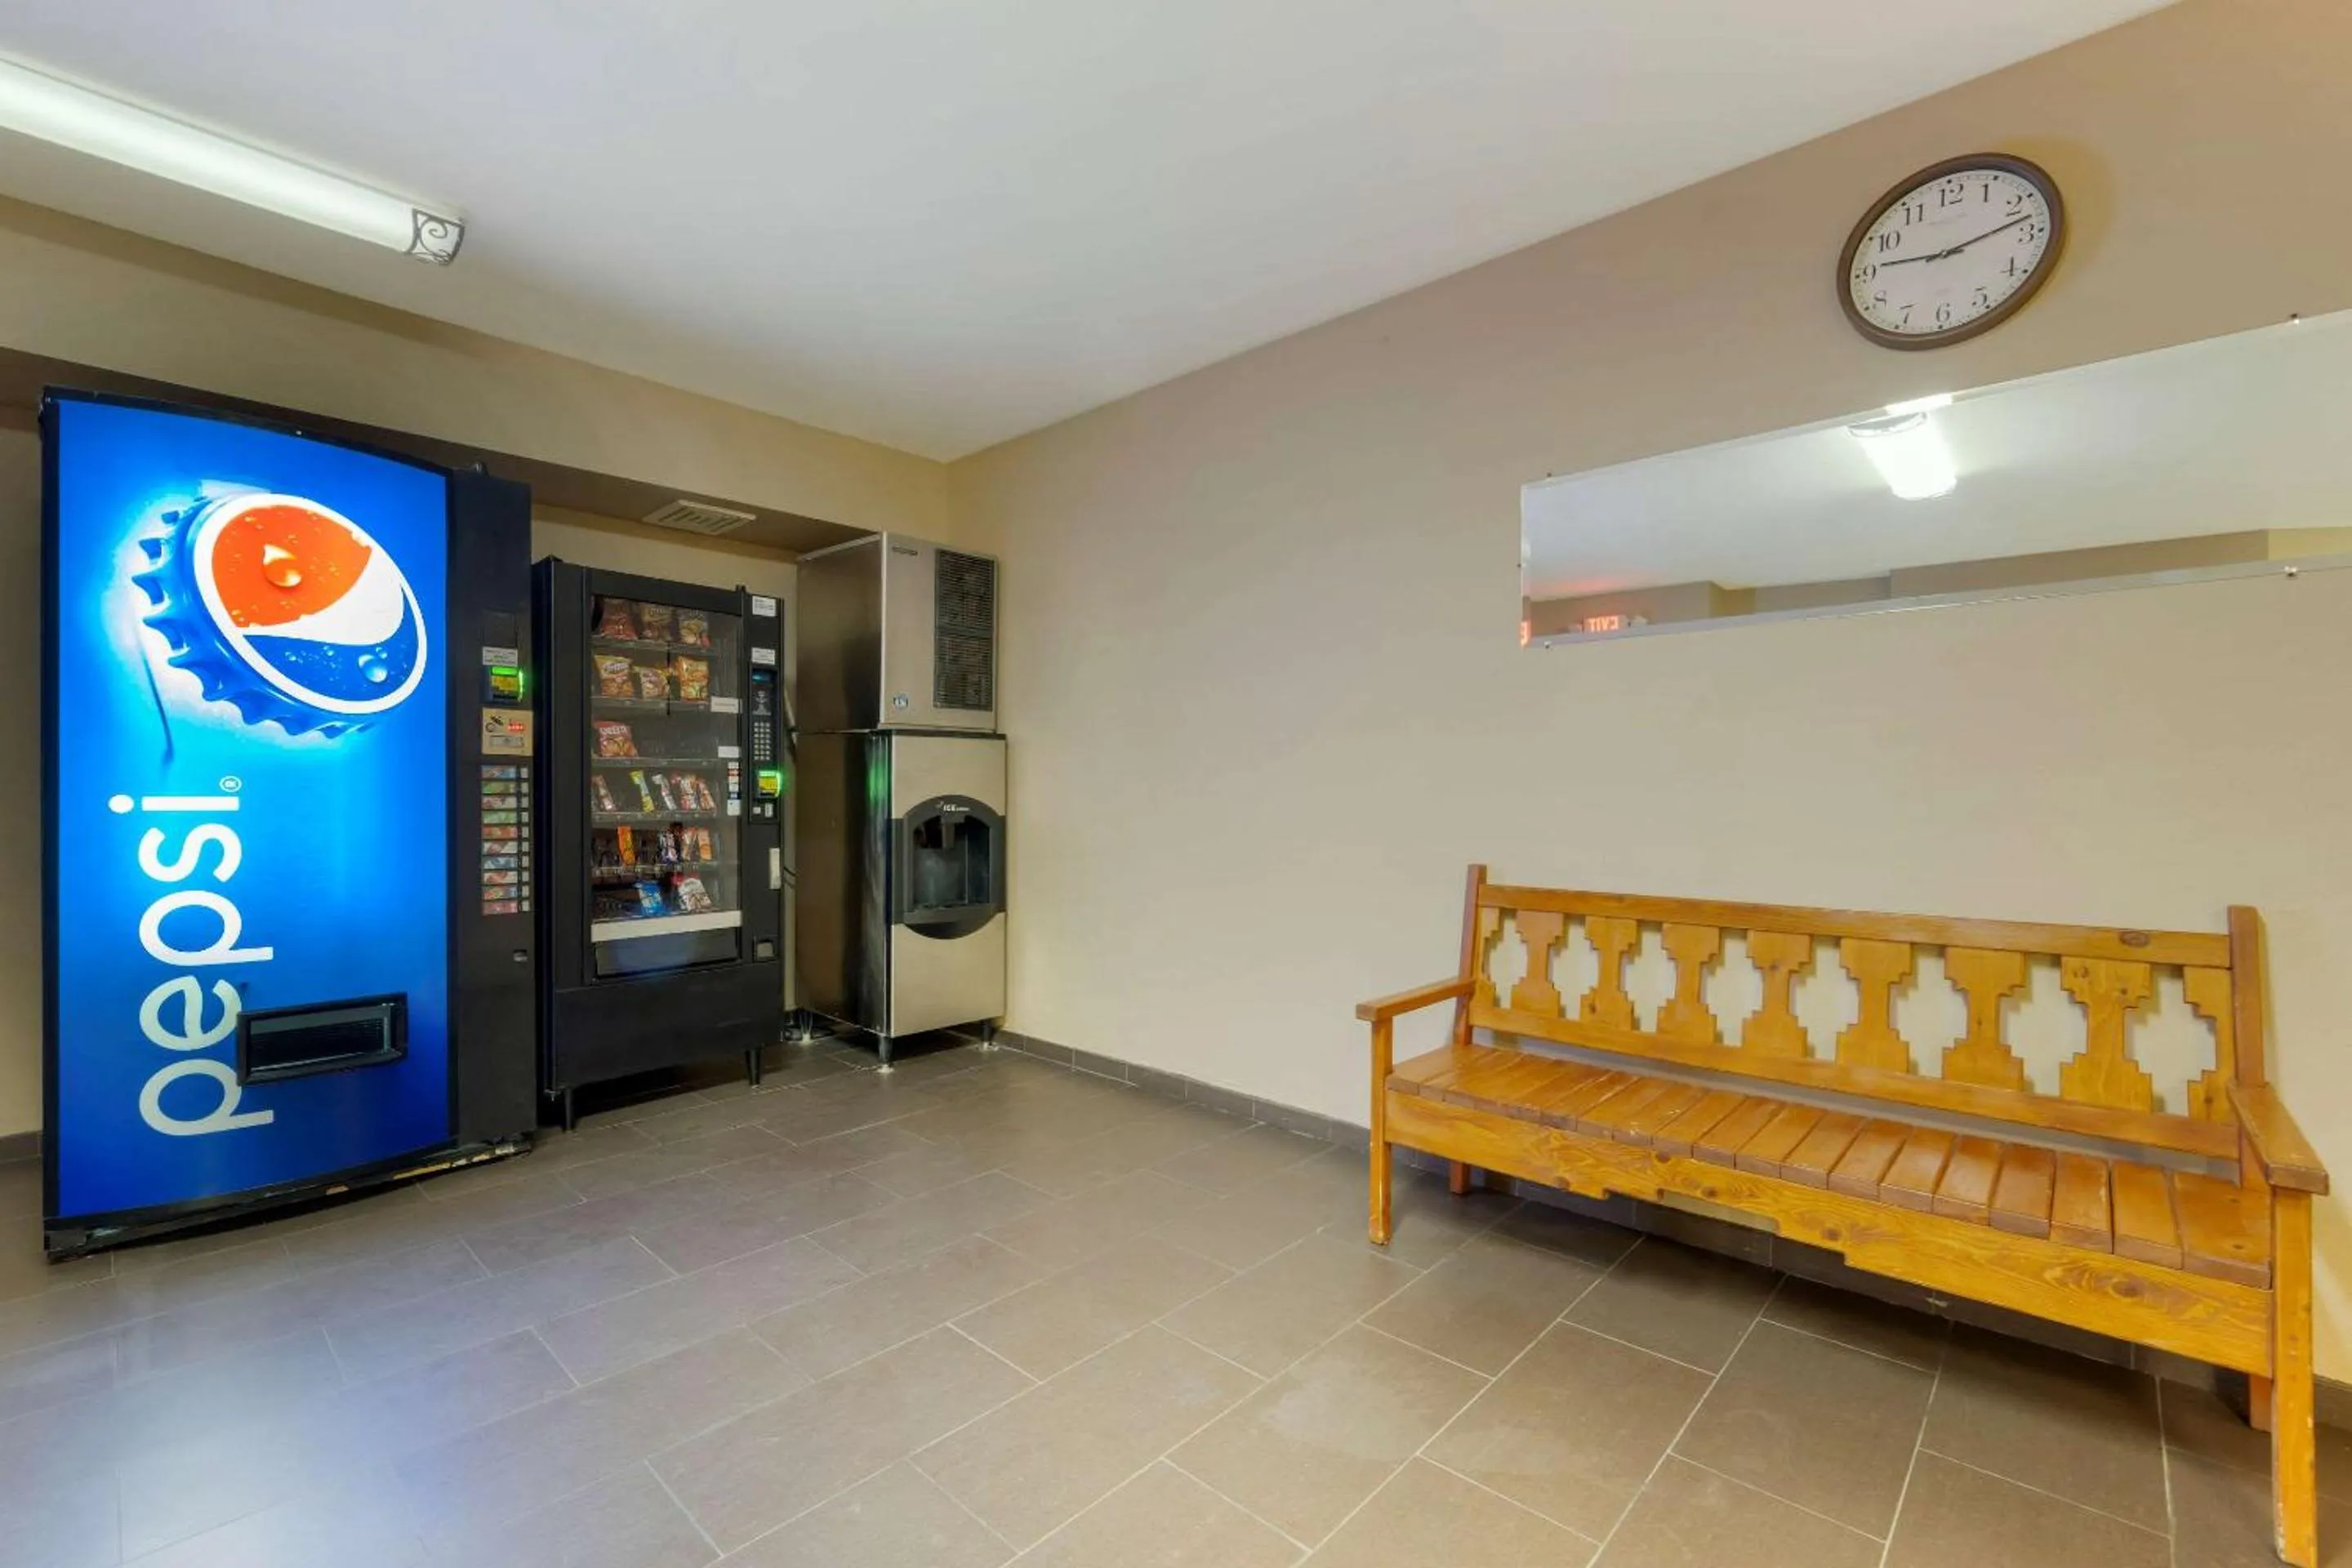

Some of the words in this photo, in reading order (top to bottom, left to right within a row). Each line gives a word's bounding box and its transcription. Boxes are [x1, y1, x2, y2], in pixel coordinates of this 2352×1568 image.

[1939, 183, 1964, 207] 12
[1981, 183, 1989, 203] 1
[1903, 203, 1923, 225] 11
[2006, 194, 2022, 217] 2
[1879, 230, 1900, 252] 10
[2019, 223, 2034, 243] 3
[1863, 264, 1877, 283] 9
[2000, 256, 2019, 276] 4
[1873, 290, 1886, 310] 8
[1972, 287, 1987, 306] 5
[1900, 303, 1915, 324] 7
[1936, 303, 1950, 323] 6
[108, 795, 274, 1136] pepsi
